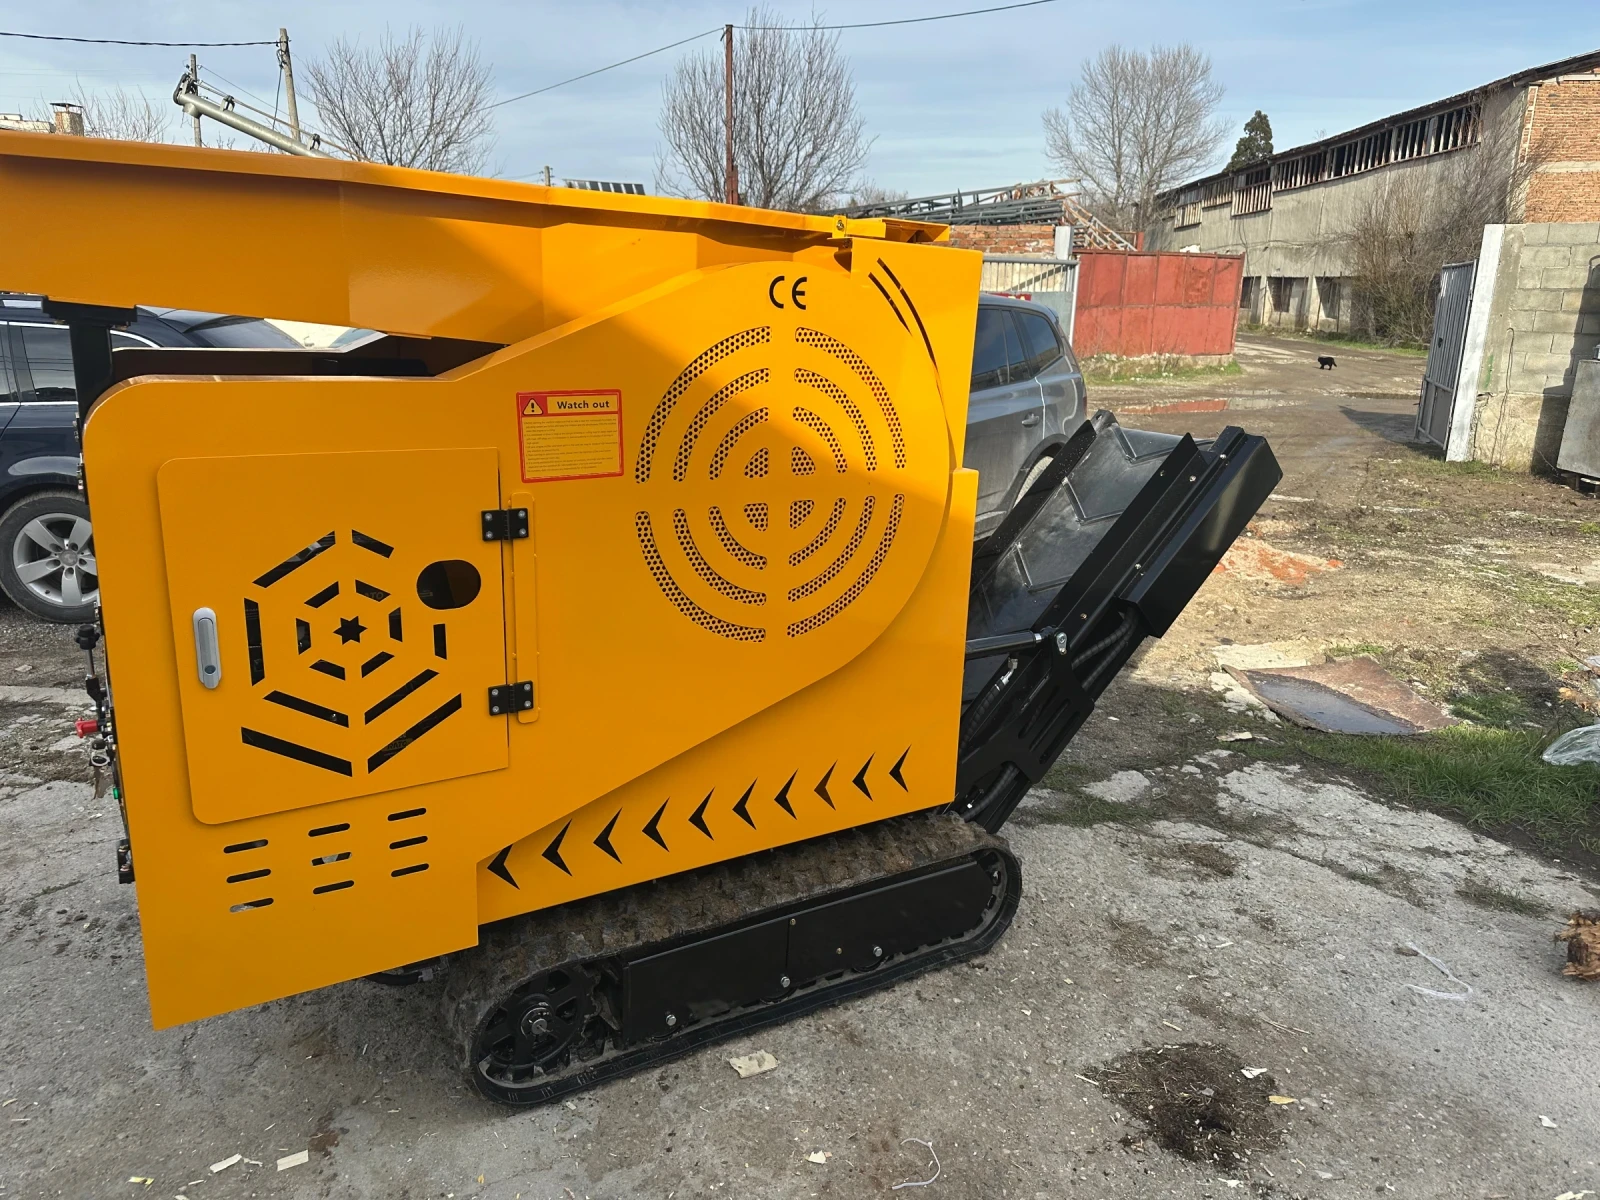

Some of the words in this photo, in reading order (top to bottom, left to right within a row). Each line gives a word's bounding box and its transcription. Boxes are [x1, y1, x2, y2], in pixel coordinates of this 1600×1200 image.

[769, 275, 808, 311] CE
[556, 400, 589, 410] Watch
[592, 401, 610, 409] out
